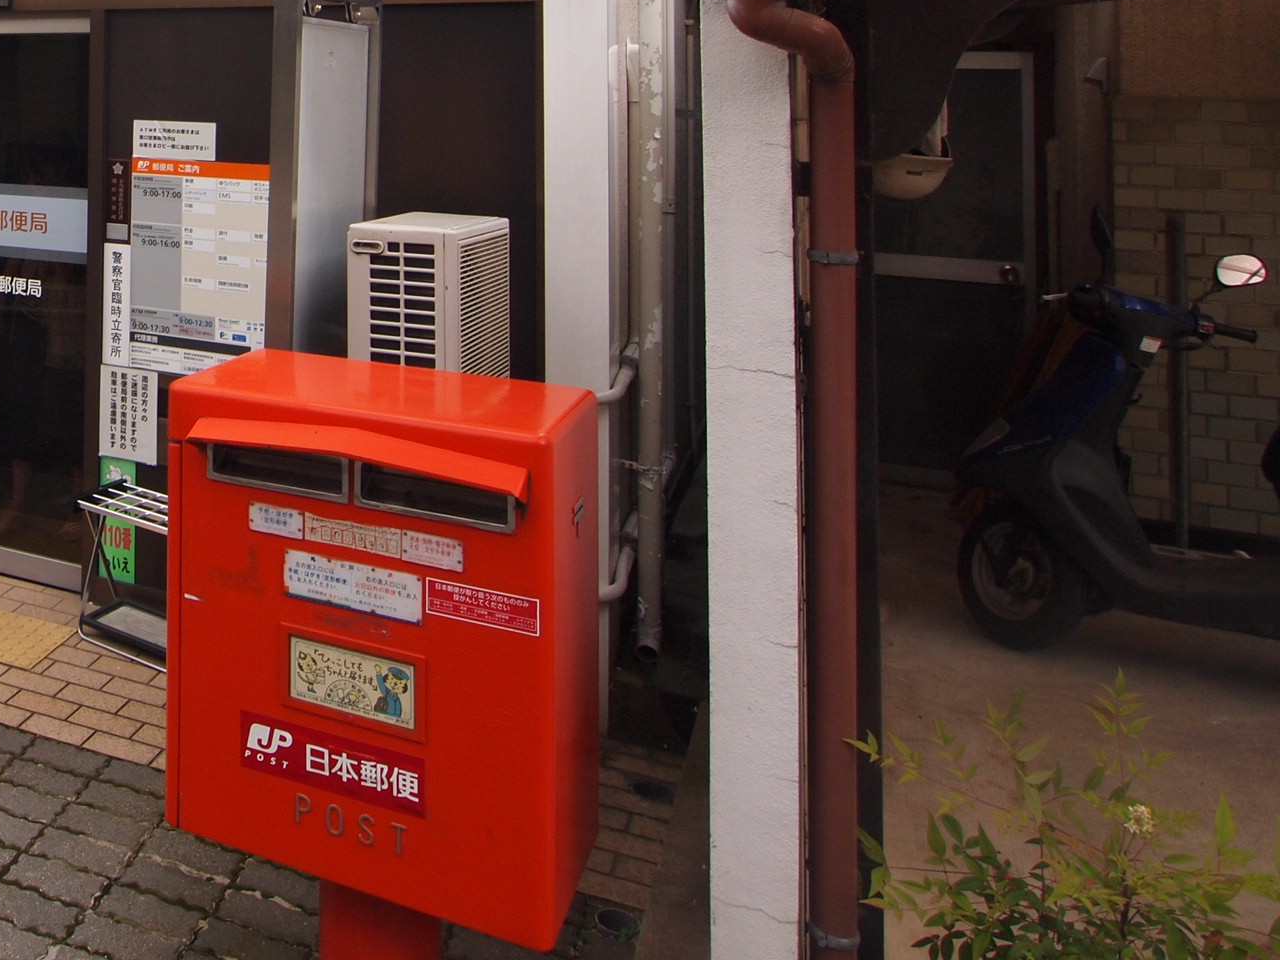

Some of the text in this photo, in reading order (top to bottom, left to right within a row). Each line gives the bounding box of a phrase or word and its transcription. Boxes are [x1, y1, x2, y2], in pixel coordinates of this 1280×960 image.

[152, 162, 174, 172] 郵便局
[178, 164, 200, 174] ご案内
[142, 189, 182, 199] 9:00-17:00
[141, 238, 180, 249] 9:00-16:00
[109, 251, 123, 359] 警察官臨時立寄所
[131, 321, 170, 334] 9:00-17:30
[179, 317, 213, 328] 9:00-12:30
[103, 523, 132, 551] 110番
[295, 561, 335, 575] 左の差入口には
[365, 576, 407, 590] 右の差入口には
[453, 594, 510, 611] 投かんしてください
[244, 749, 289, 769] POST
[246, 723, 419, 803] JP 日本郵便
[295, 792, 408, 856] POST
